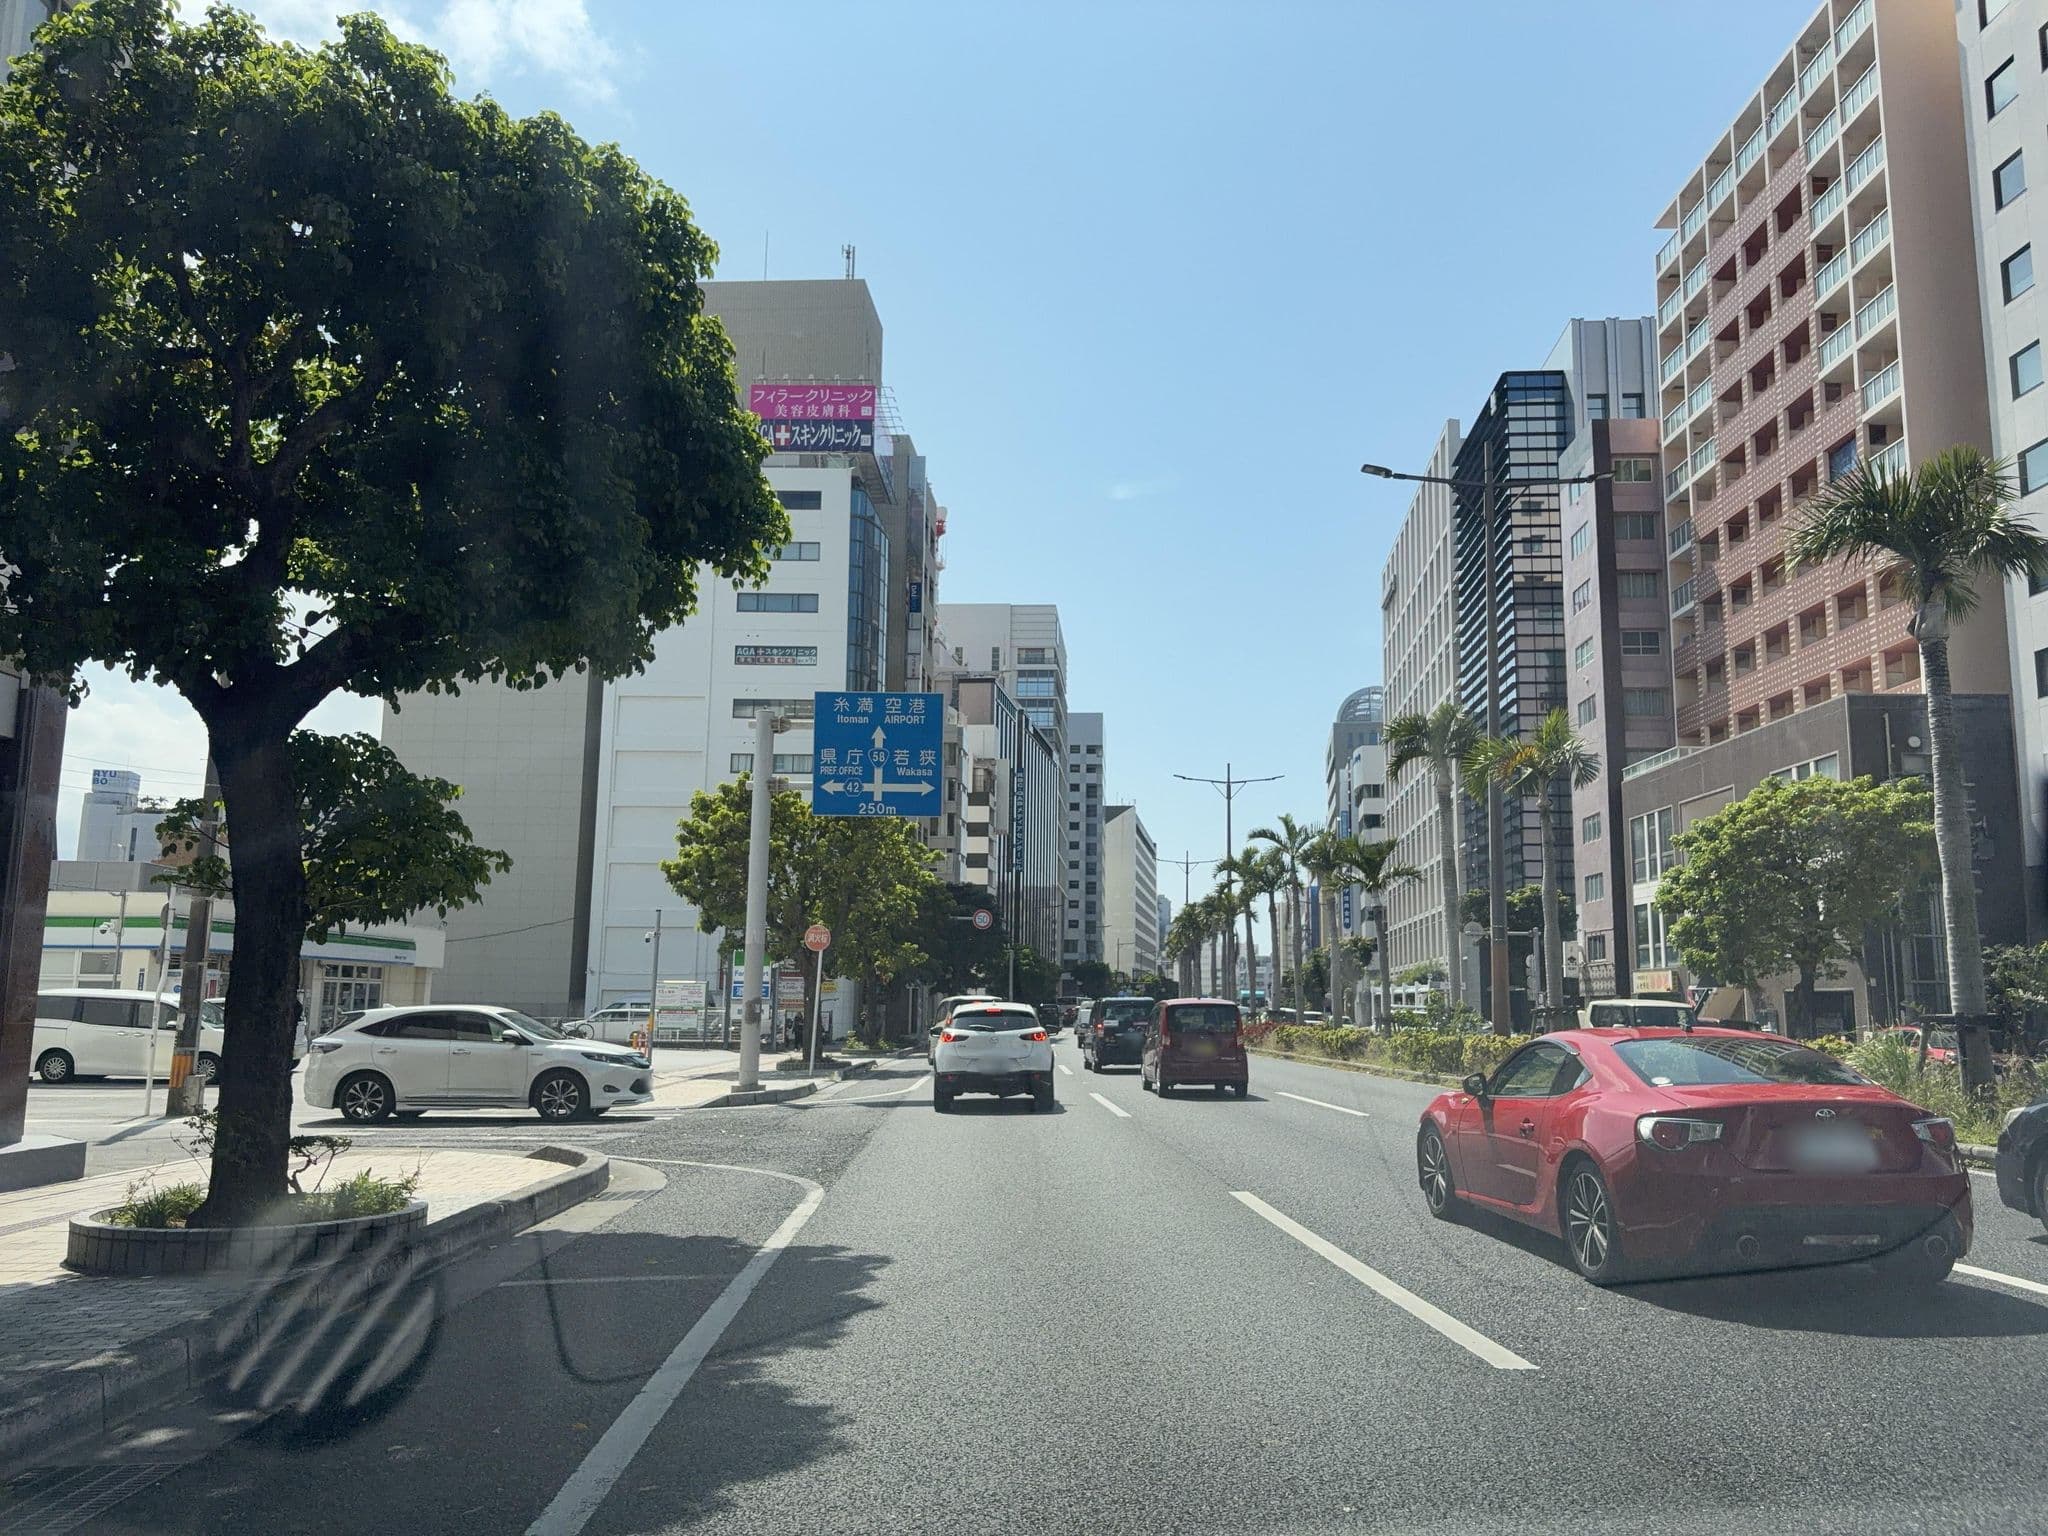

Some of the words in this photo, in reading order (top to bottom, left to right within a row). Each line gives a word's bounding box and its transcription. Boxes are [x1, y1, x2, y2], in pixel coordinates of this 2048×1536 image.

[753, 389, 873, 404] フィラークリニック
[775, 404, 851, 418] 美容皮膚科
[791, 424, 861, 447] スキンクリニック
[834, 697, 873, 713] 糸満
[885, 697, 925, 714] 空港
[837, 715, 869, 724] Itoman
[884, 715, 926, 724] AIRPORT
[820, 748, 863, 765] 県庁
[872, 751, 885, 762] 58
[893, 749, 936, 766] 若狭
[93, 770, 117, 778] RYU
[896, 767, 933, 777] Wakasa
[846, 782, 860, 793] 42
[858, 803, 897, 815] 250m
